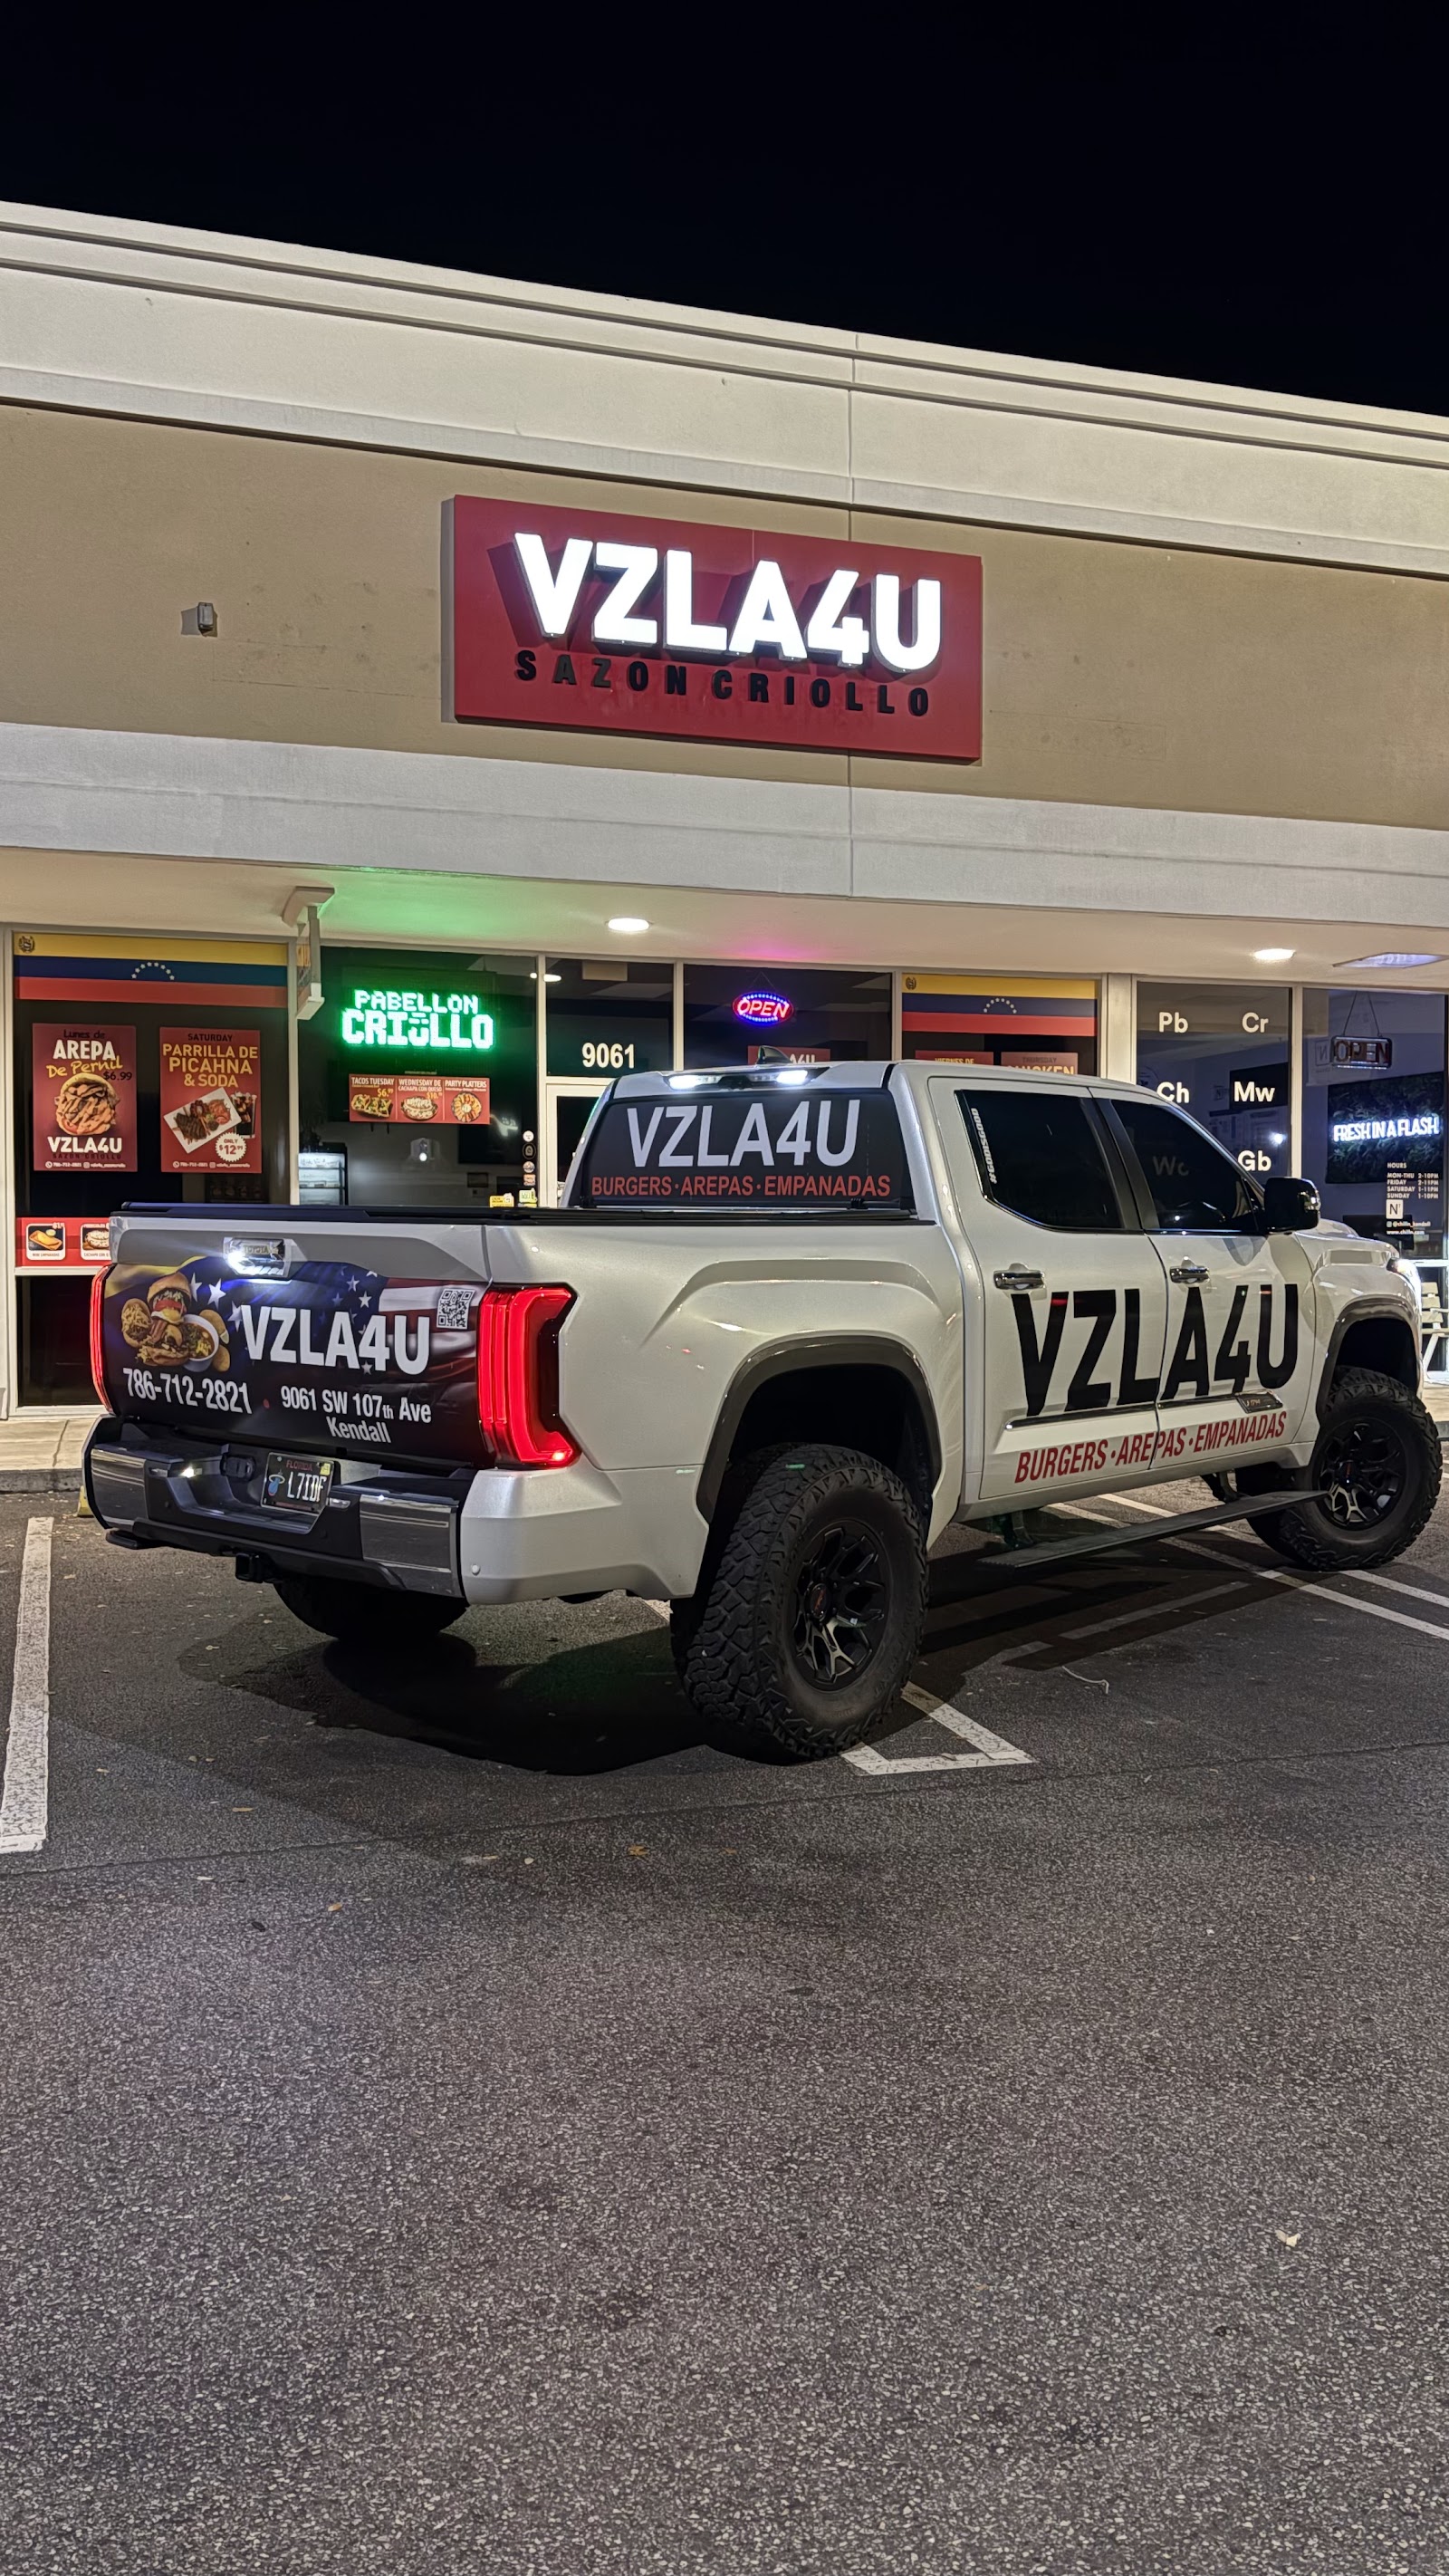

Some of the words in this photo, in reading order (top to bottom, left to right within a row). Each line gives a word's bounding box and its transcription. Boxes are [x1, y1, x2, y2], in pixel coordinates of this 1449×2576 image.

[514, 533, 941, 672] VZLA4U
[516, 650, 686, 695] SAZON
[714, 670, 929, 716] CRIOLLO
[354, 989, 479, 1014] PABELLON
[736, 997, 792, 1020] OPEN
[1159, 1012, 1188, 1033] Pb
[1242, 1012, 1269, 1033] Cr
[187, 1033, 233, 1042] SATURDAY
[53, 1039, 116, 1061] AREPA
[162, 1043, 235, 1058] PARRILLA
[239, 1046, 258, 1059] DE
[582, 1042, 635, 1069] 9061
[1335, 1040, 1388, 1063] OPEN
[46, 1064, 68, 1078] De
[71, 1055, 123, 1074] Pernil
[103, 1072, 132, 1081] $6.99
[168, 1057, 253, 1074] PICAHNA
[184, 1073, 196, 1087] &
[197, 1073, 238, 1088] SODA
[351, 1077, 369, 1085] TACOS
[1156, 1081, 1190, 1103] Ch
[1233, 1081, 1275, 1102] Mw
[627, 1099, 860, 1168] VZLA4U
[1333, 1122, 1371, 1142] FRESH
[1372, 1120, 1386, 1139] IN
[1387, 1120, 1396, 1138] A
[1397, 1114, 1440, 1138] FLASH
[47, 1136, 122, 1154] VZLA4U
[1237, 1150, 1271, 1171] Gb
[591, 1176, 672, 1197] BURGERS
[680, 1176, 753, 1197] AREPAS
[763, 1175, 891, 1197] EMPANADAS
[240, 1304, 431, 1375] VZLA4U
[1011, 1284, 1299, 1417] VZLA4U
[123, 1368, 253, 1415] 786-712-2821
[281, 1385, 318, 1412] 9061
[322, 1390, 349, 1416] SW
[352, 1392, 394, 1421] 107th
[399, 1399, 432, 1425] Ave
[326, 1416, 391, 1444] Kendall
[1014, 1438, 1108, 1484] BURGERS
[1115, 1428, 1187, 1466] AREPAS
[1193, 1410, 1287, 1453] EMPANADAS
